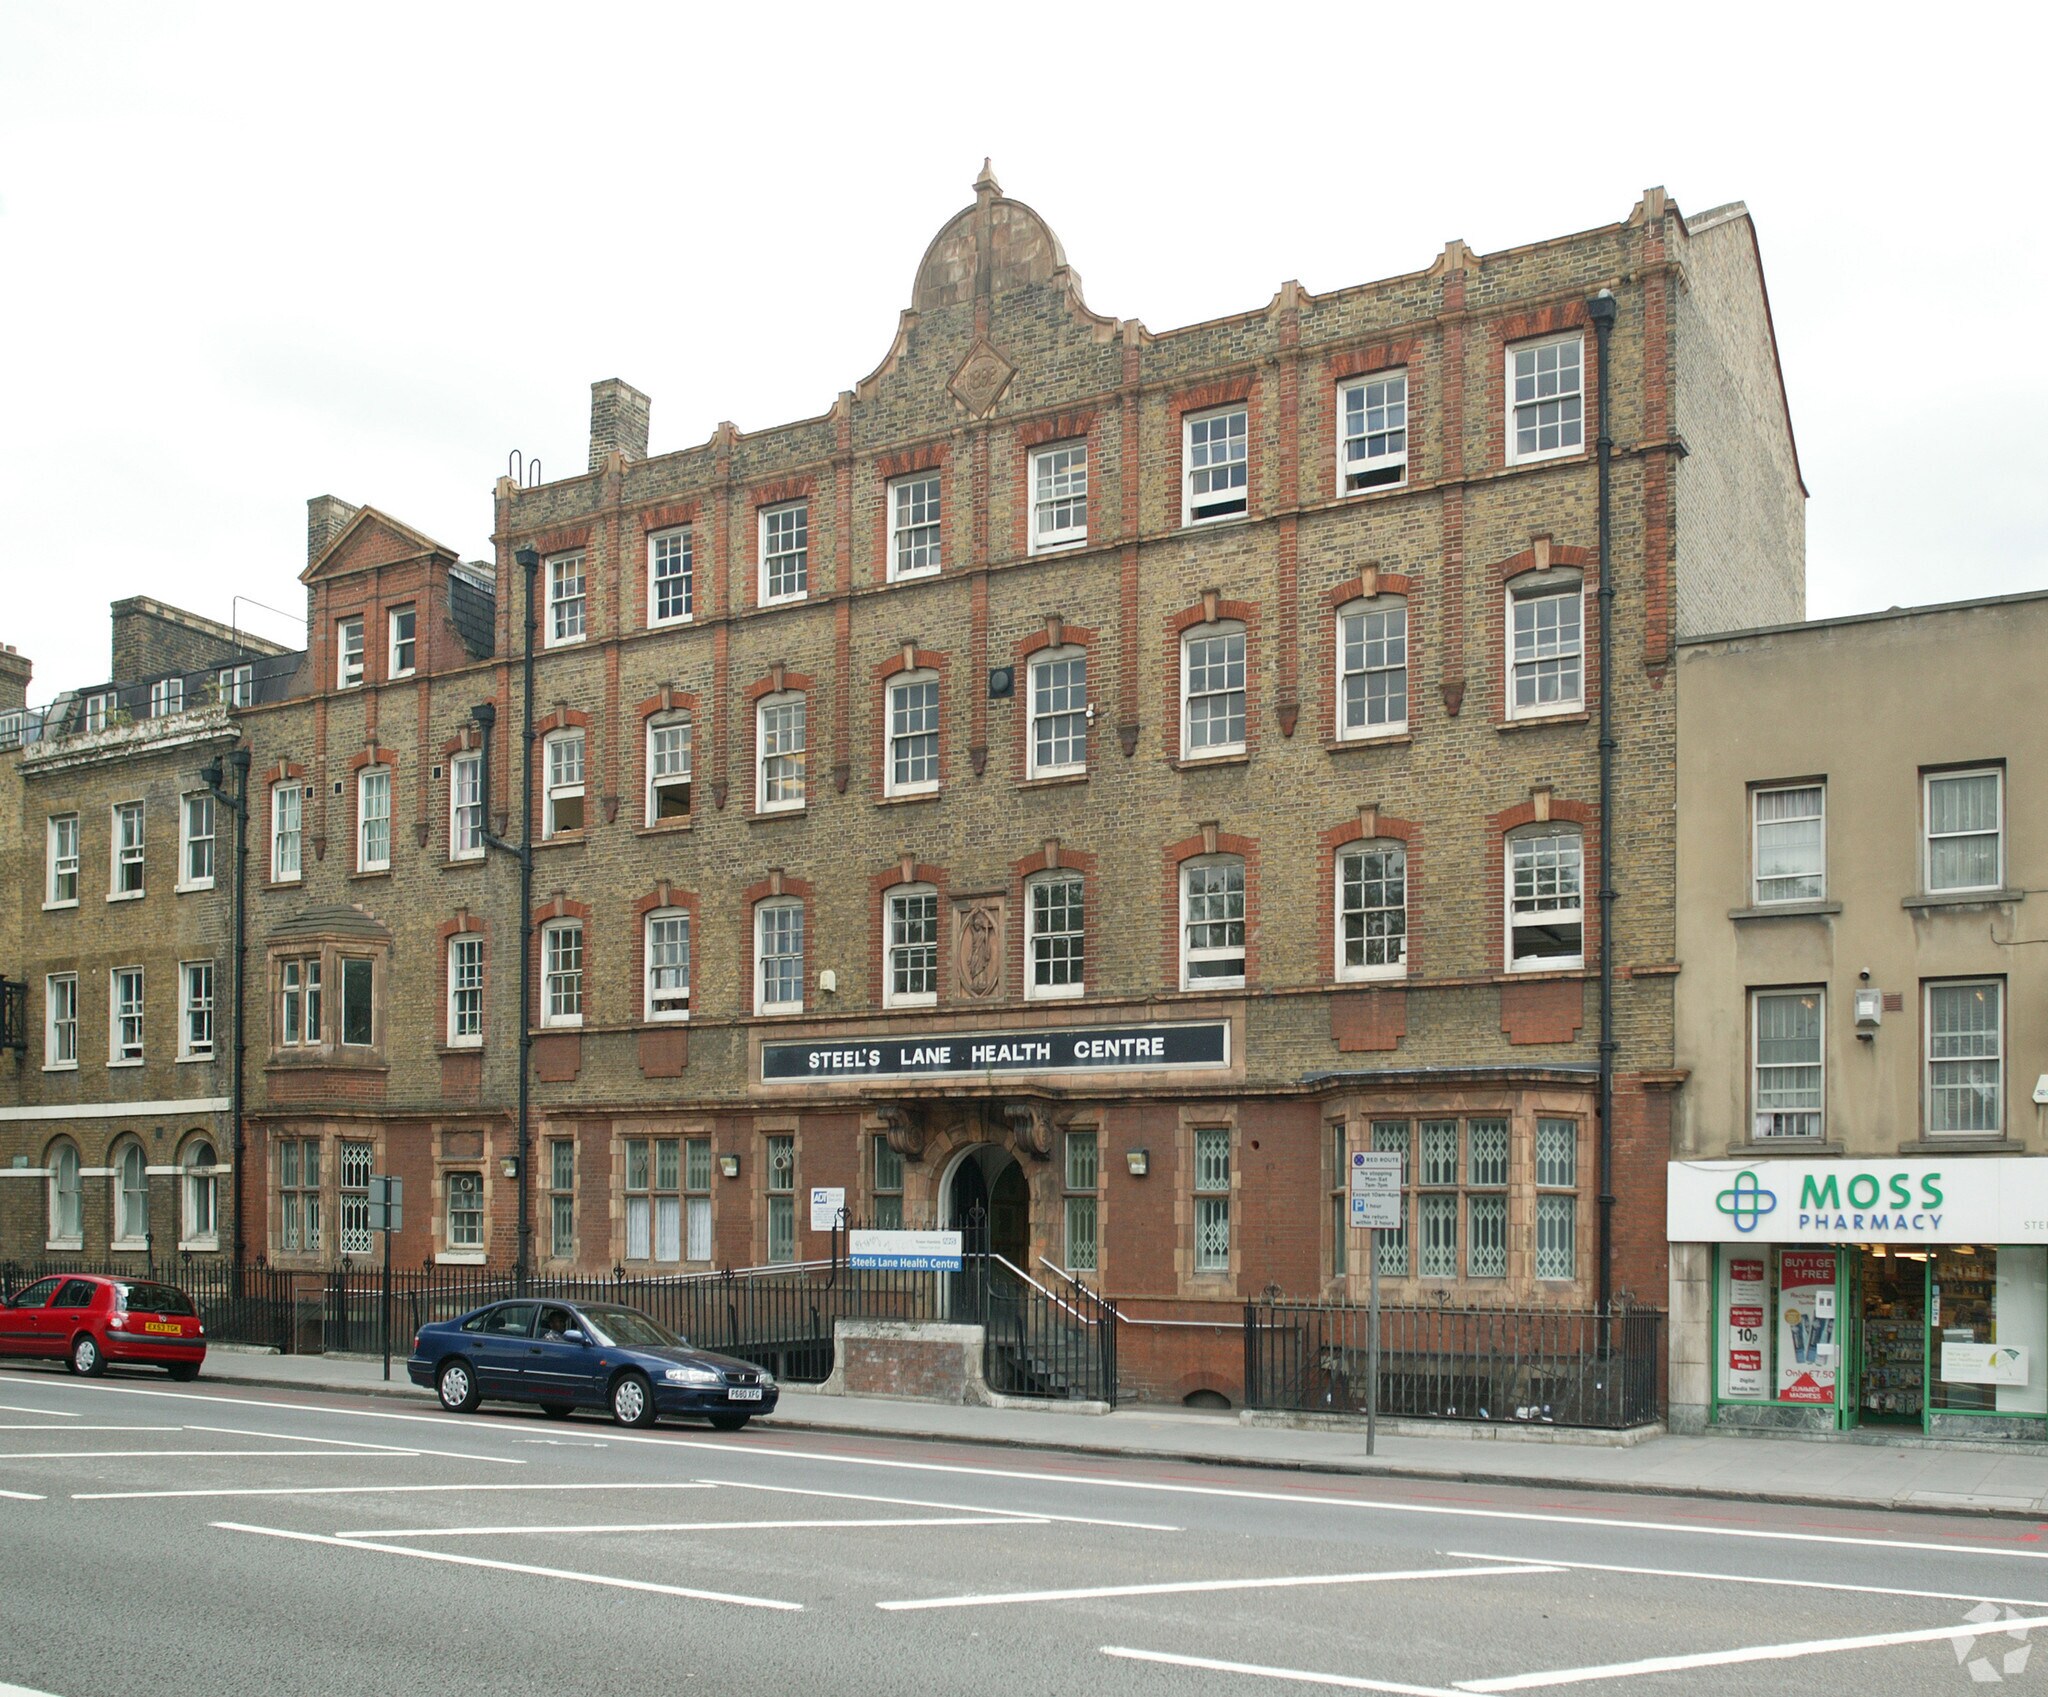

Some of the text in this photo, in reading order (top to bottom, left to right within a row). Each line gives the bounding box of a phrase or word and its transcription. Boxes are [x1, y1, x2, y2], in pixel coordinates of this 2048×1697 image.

[808, 1037, 1165, 1068] STEEL'S LANE HEALTH CENTRE
[813, 1192, 827, 1203] ADT
[1800, 1172, 1944, 1210] MOSS
[1355, 1200, 1362, 1211] P
[1799, 1214, 1943, 1230] PHARMACY
[851, 1256, 959, 1269] Steels Lane Health Centre
[1785, 1258, 1806, 1267] BUY
[1802, 1270, 1830, 1278] FREE
[1737, 1328, 1758, 1344] 10p
